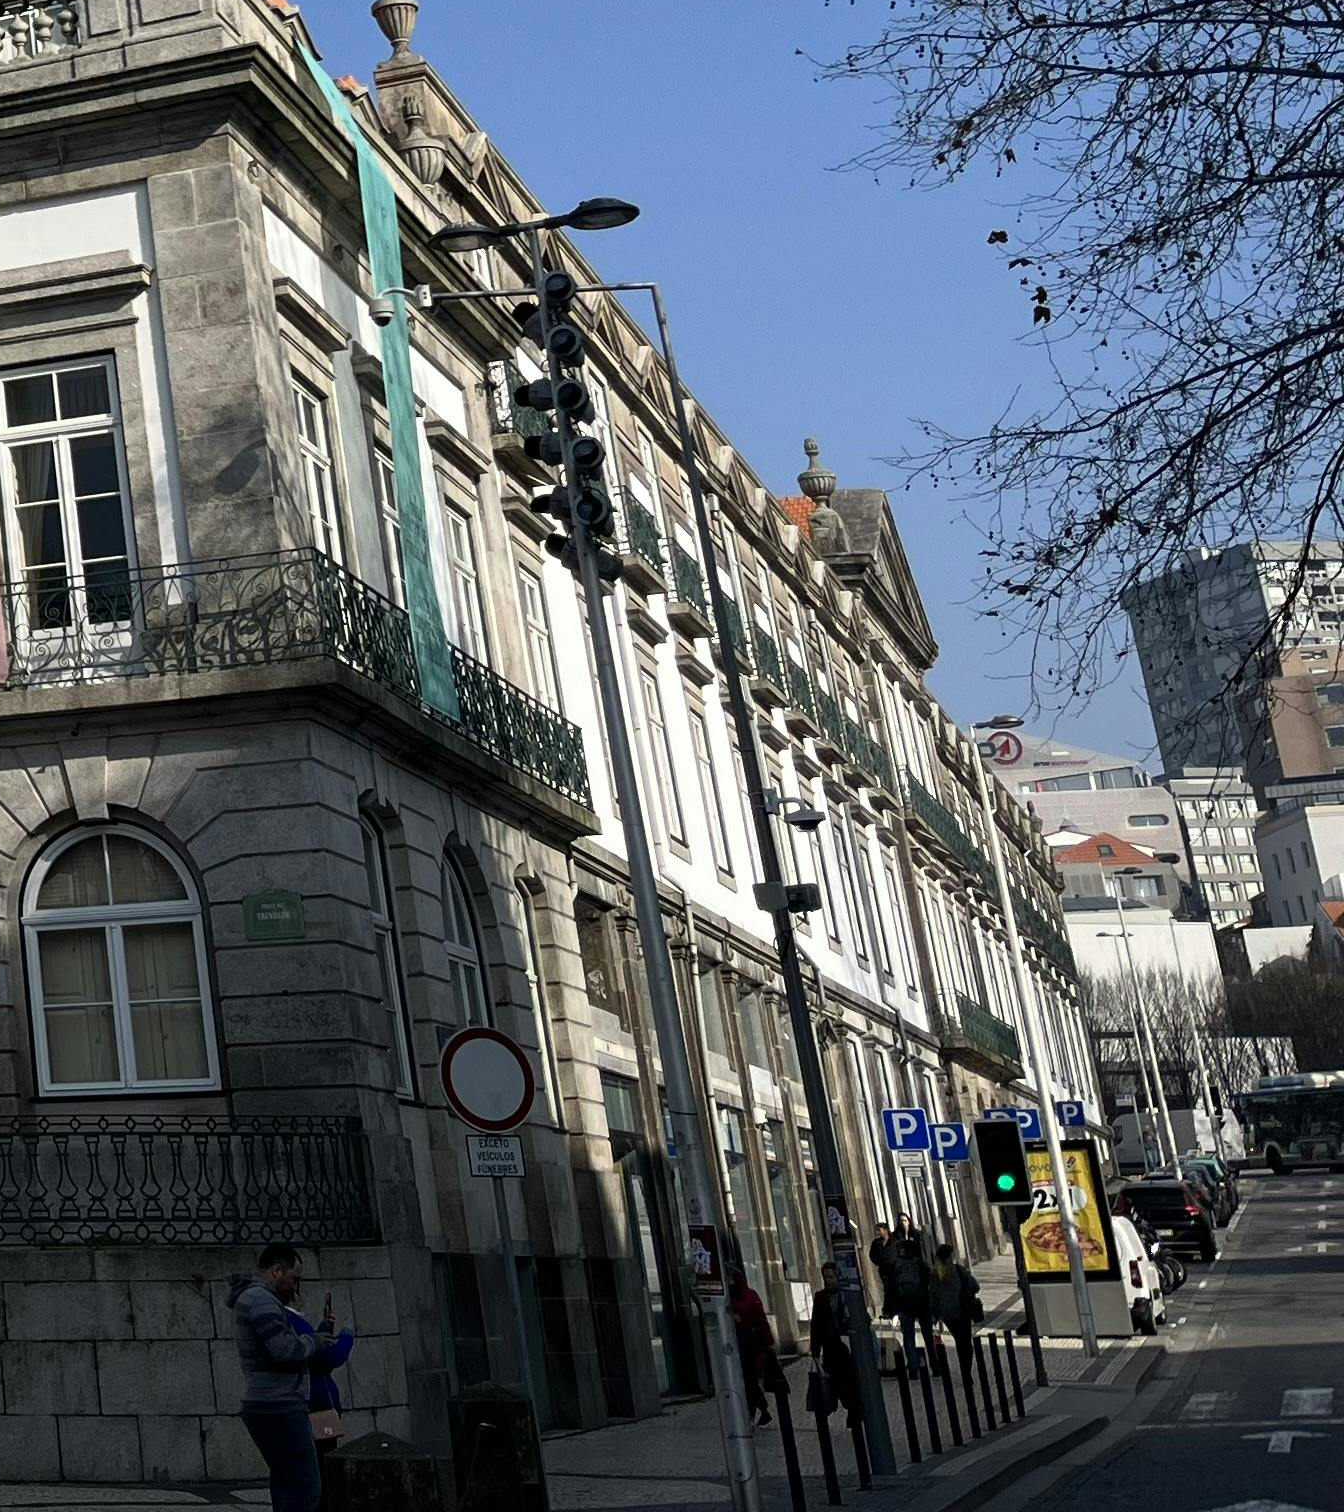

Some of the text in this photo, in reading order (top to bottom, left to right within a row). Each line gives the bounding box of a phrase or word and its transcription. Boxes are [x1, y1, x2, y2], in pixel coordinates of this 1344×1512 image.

[1062, 1104, 1078, 1124] P
[891, 1112, 918, 1146] P
[479, 1139, 509, 1148] EXCETO
[934, 1127, 958, 1158] P
